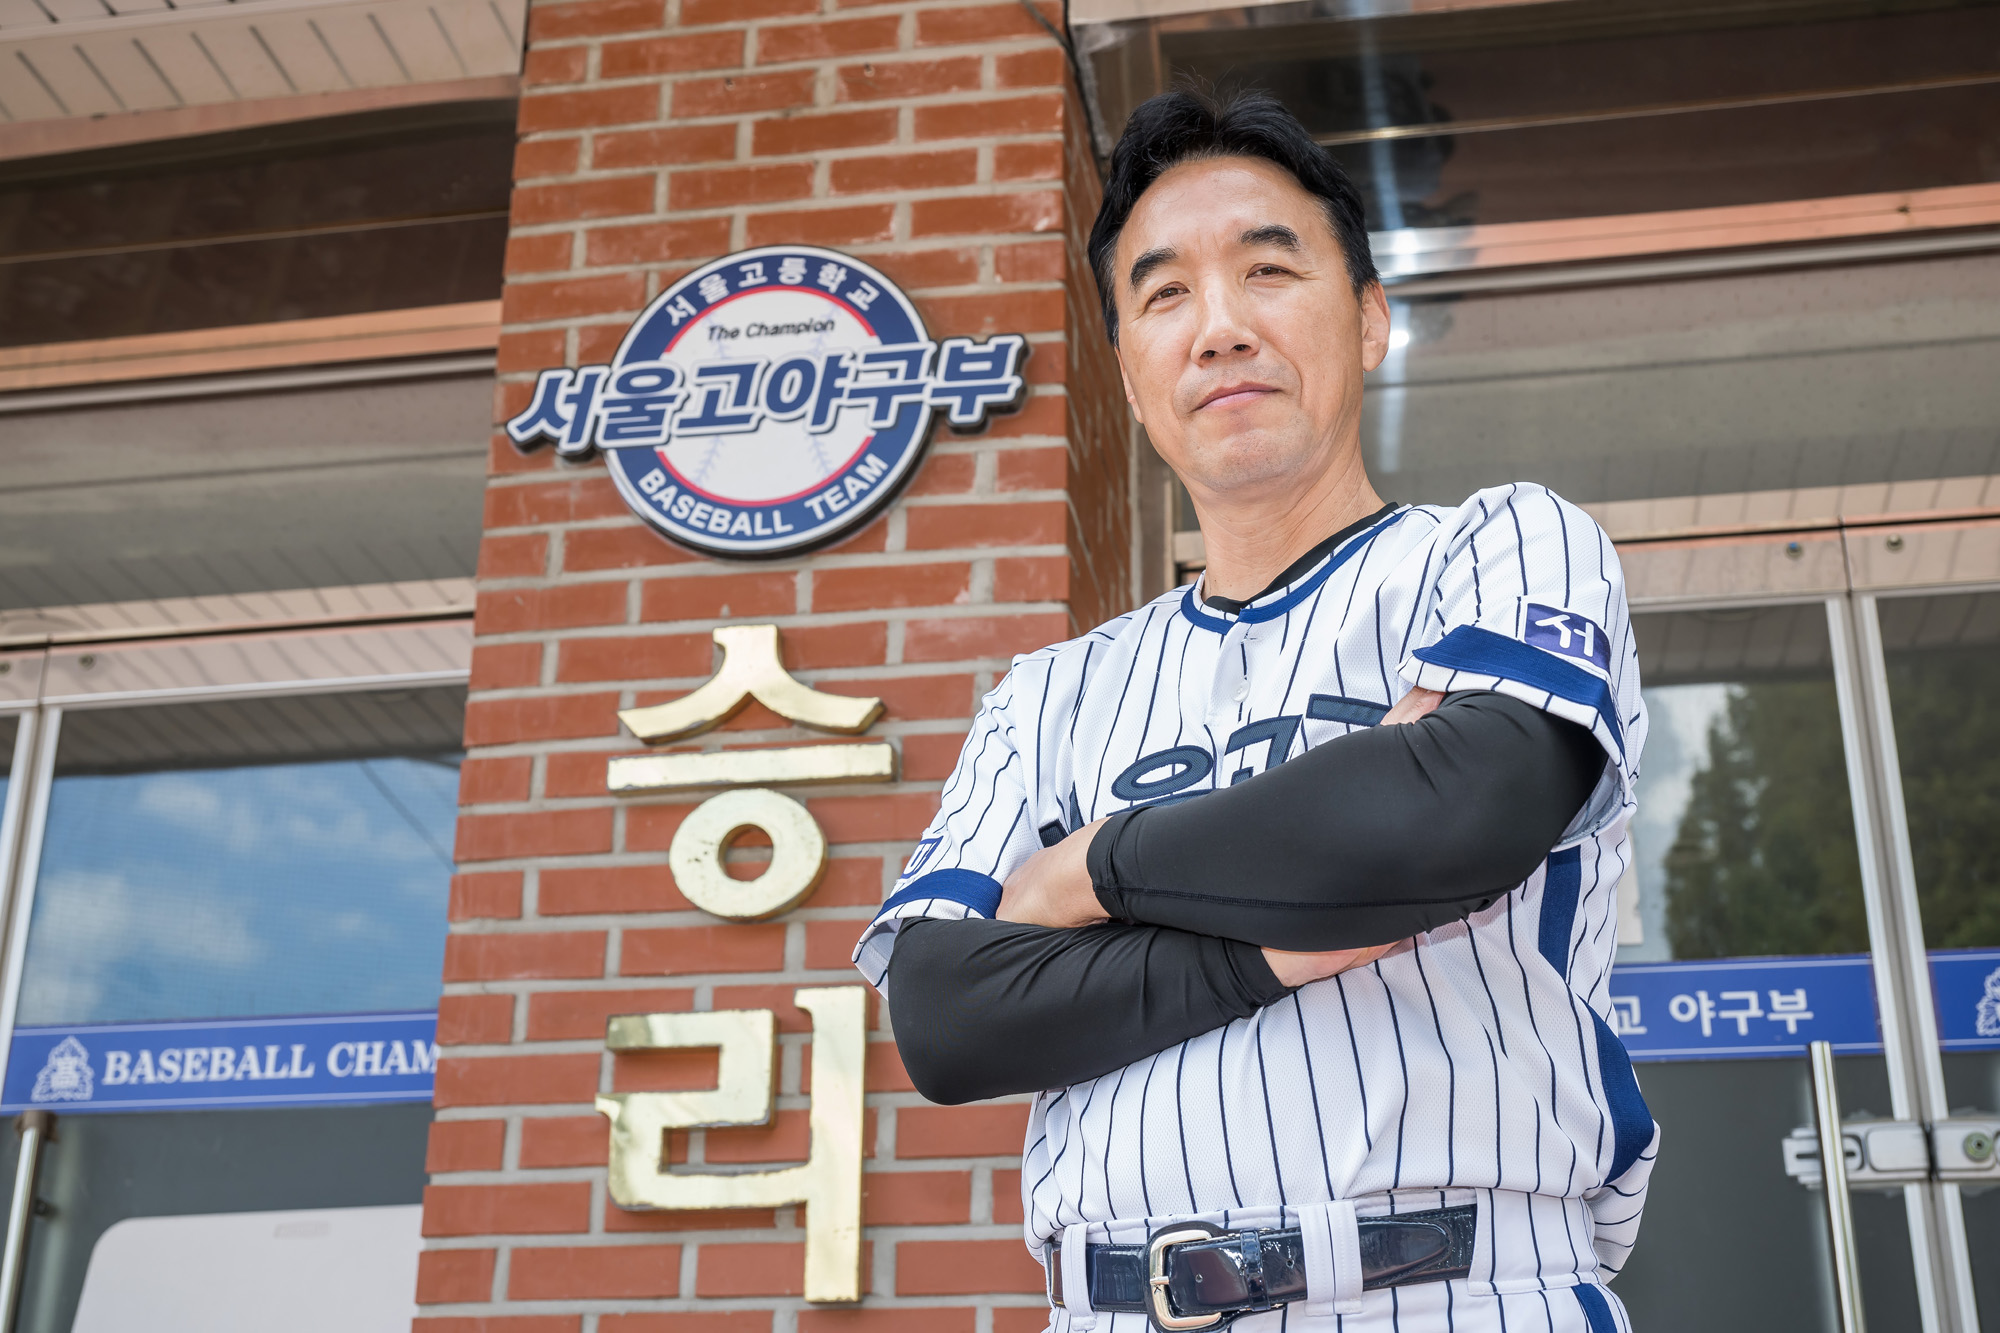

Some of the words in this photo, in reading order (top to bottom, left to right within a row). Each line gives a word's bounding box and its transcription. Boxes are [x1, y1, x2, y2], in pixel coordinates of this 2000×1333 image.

[665, 257, 881, 327] 서울고등학교
[707, 324, 741, 342] The
[746, 317, 836, 340] Champion
[506, 334, 1029, 452] 서울고야구부
[637, 467, 794, 537] BASEBALL
[804, 452, 889, 521] TEAM
[595, 624, 900, 1304] 승리
[1668, 987, 1815, 1038] 야구부
[102, 1044, 315, 1086] BASEBALL
[326, 1039, 438, 1078] CHAM
